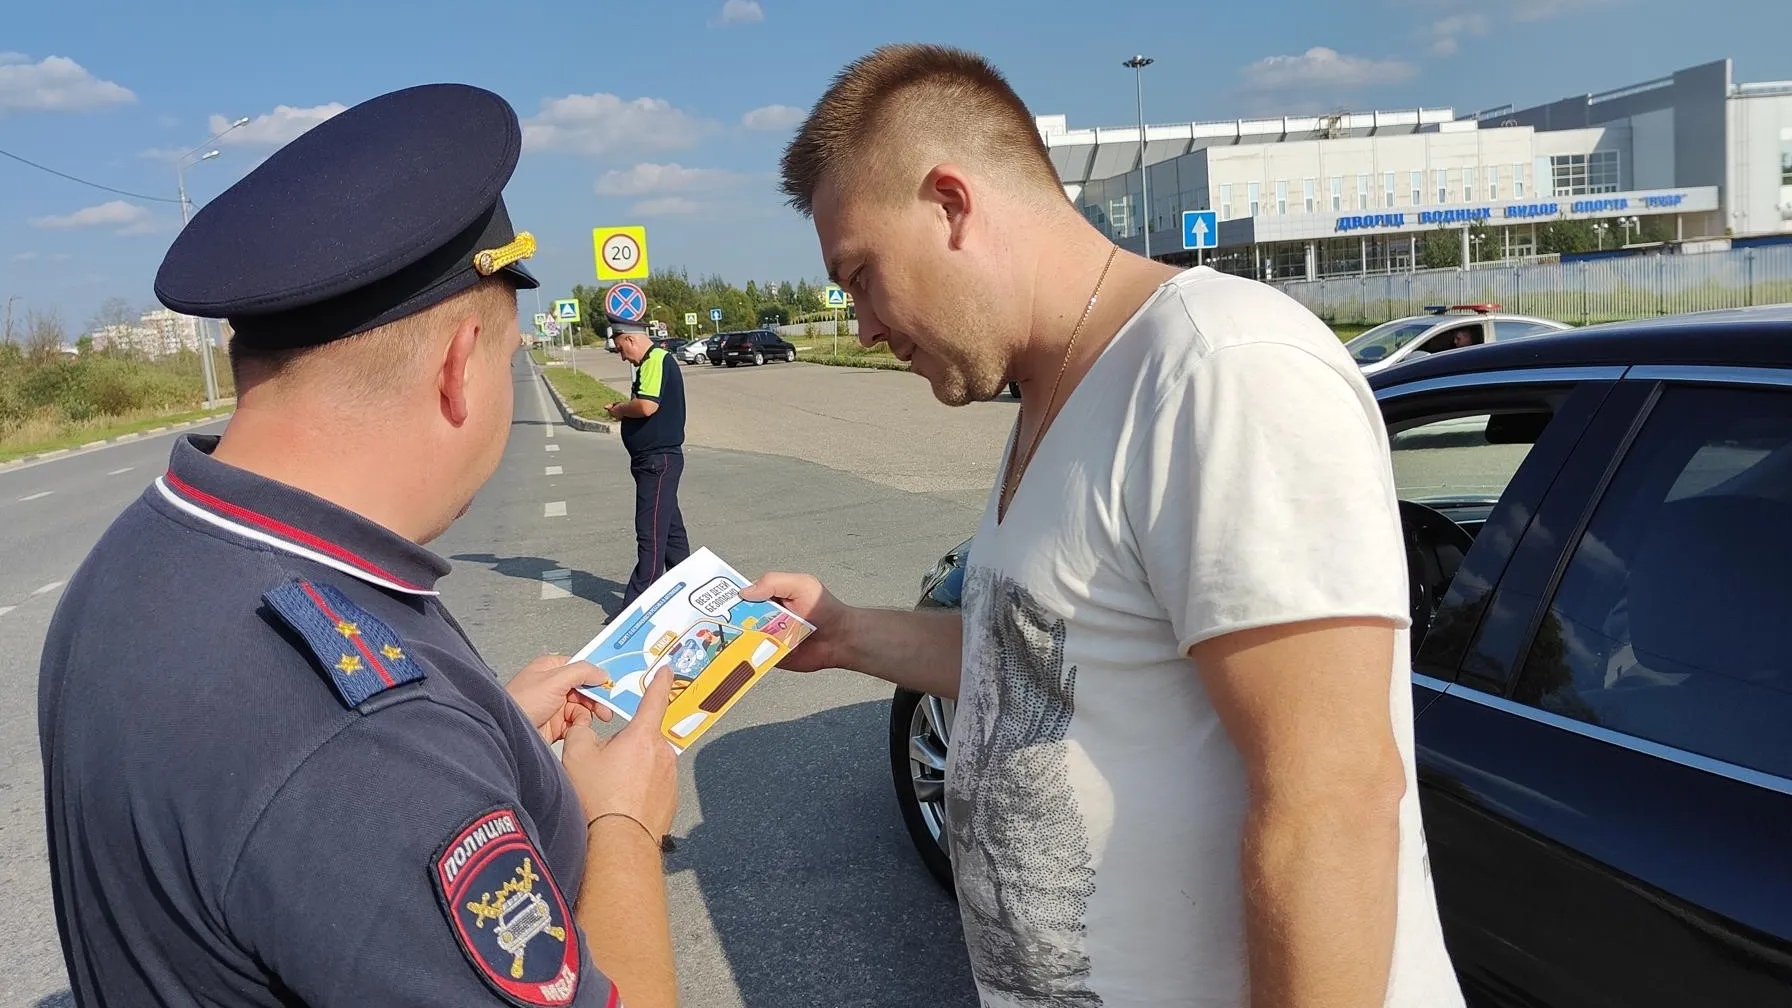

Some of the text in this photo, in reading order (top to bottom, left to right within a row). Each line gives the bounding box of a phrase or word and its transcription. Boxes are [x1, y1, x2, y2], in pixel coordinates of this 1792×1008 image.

[1335, 213, 1404, 232] ДВОРЕЦ
[1418, 207, 1491, 224] ВОДНЫХ
[1504, 203, 1558, 218] ВИДОВ
[611, 245, 632, 261] 20
[695, 580, 731, 606] ВЕЗУ ДЕТЕЙ
[443, 815, 516, 882] ПОЛИЦИЯ
[539, 964, 577, 1001] МВД
